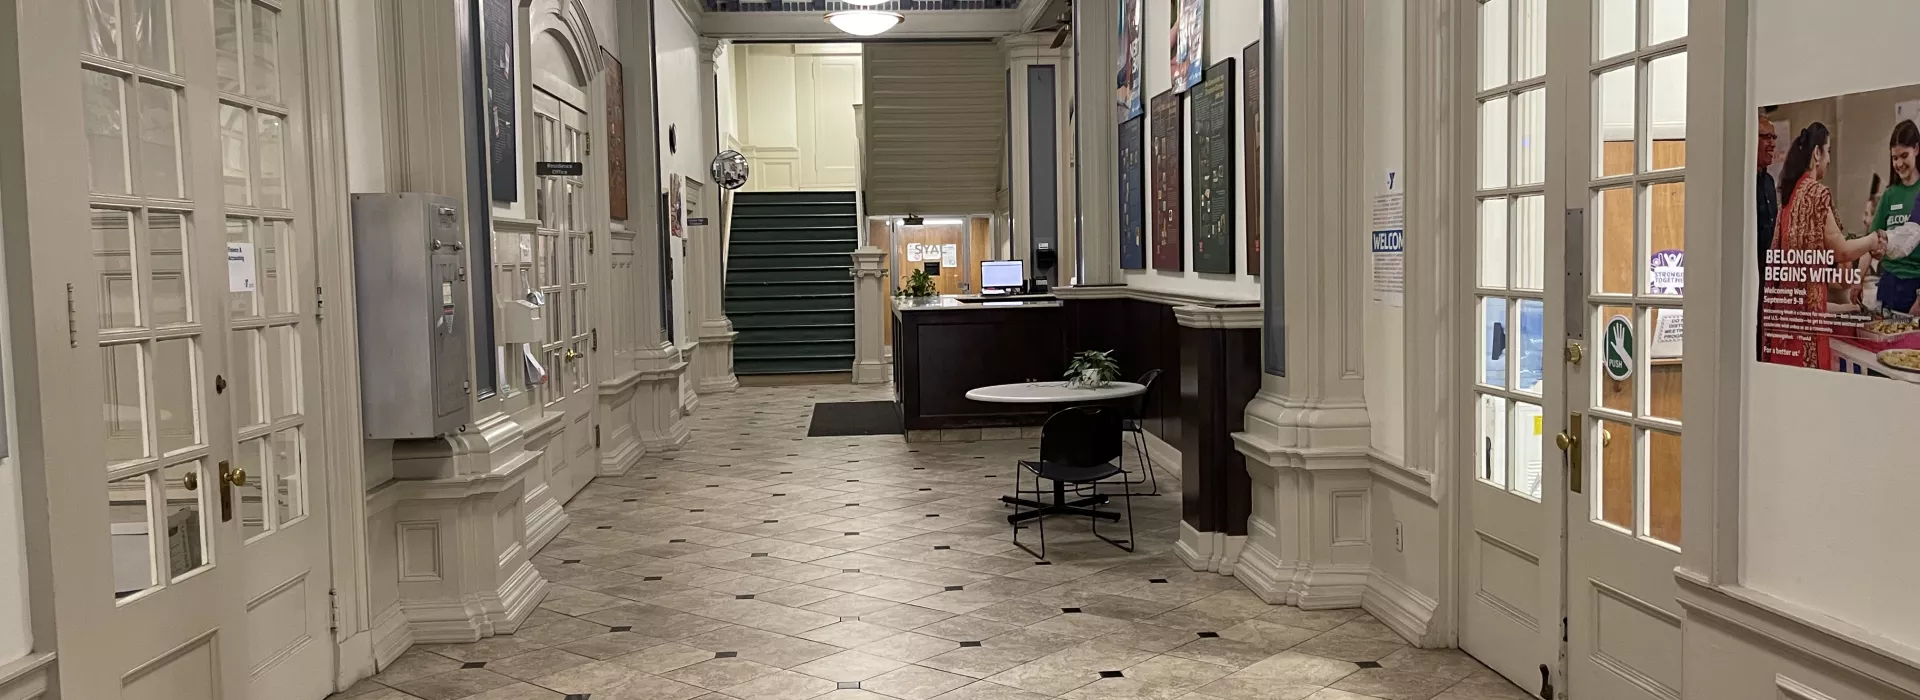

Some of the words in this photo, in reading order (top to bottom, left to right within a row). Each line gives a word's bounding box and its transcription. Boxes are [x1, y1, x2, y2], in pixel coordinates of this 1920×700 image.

[1766, 250, 1834, 266] BELONGING
[1764, 266, 1806, 282] BEGINS
[1810, 268, 1842, 284] WITH
[1845, 269, 1861, 284] US
[1764, 296, 1792, 304] September
[1776, 347, 1791, 355] better
[1608, 359, 1622, 368] PUSH
